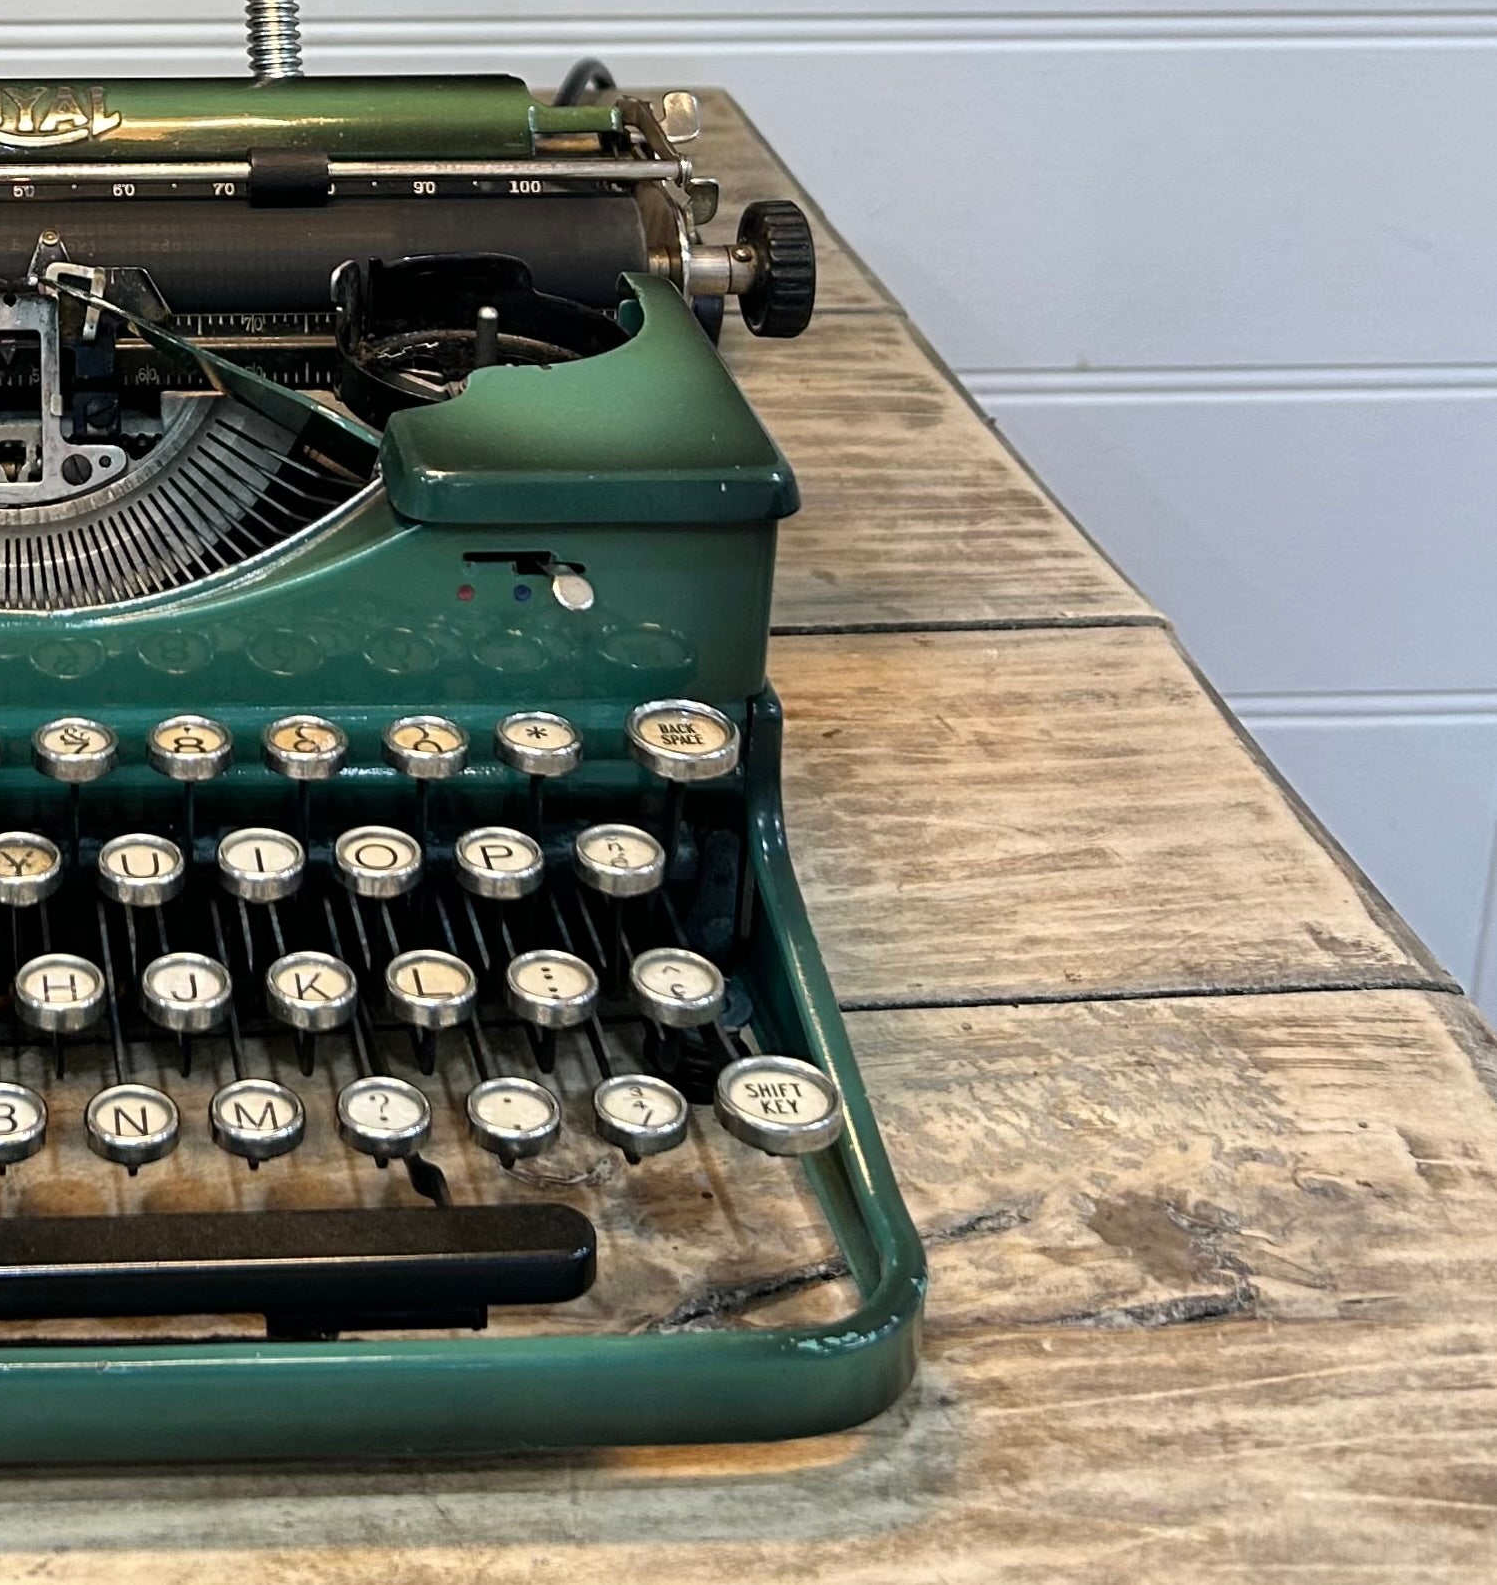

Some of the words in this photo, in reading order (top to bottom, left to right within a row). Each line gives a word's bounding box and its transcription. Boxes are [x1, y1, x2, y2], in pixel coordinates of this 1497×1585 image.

[13, 184, 36, 198] 50
[112, 182, 135, 196] 60
[212, 182, 235, 196] 70
[412, 180, 436, 194] 90
[508, 180, 541, 193] 100
[243, 316, 264, 332] 70
[137, 367, 158, 382] 60
[657, 723, 696, 735] BACK
[662, 733, 704, 746] SPACE
[0, 850, 34, 877] Y
[121, 851, 160, 878] U
[254, 846, 265, 872] I
[355, 843, 398, 870] O
[480, 844, 513, 870] P
[43, 973, 78, 1001] H
[171, 972, 199, 1001] J
[294, 972, 333, 1000] K
[411, 966, 454, 997] L
[744, 1082, 803, 1099] SHIFT
[113, 1104, 148, 1135] N
[233, 1099, 279, 1129] M
[761, 1098, 800, 1115] KEY
